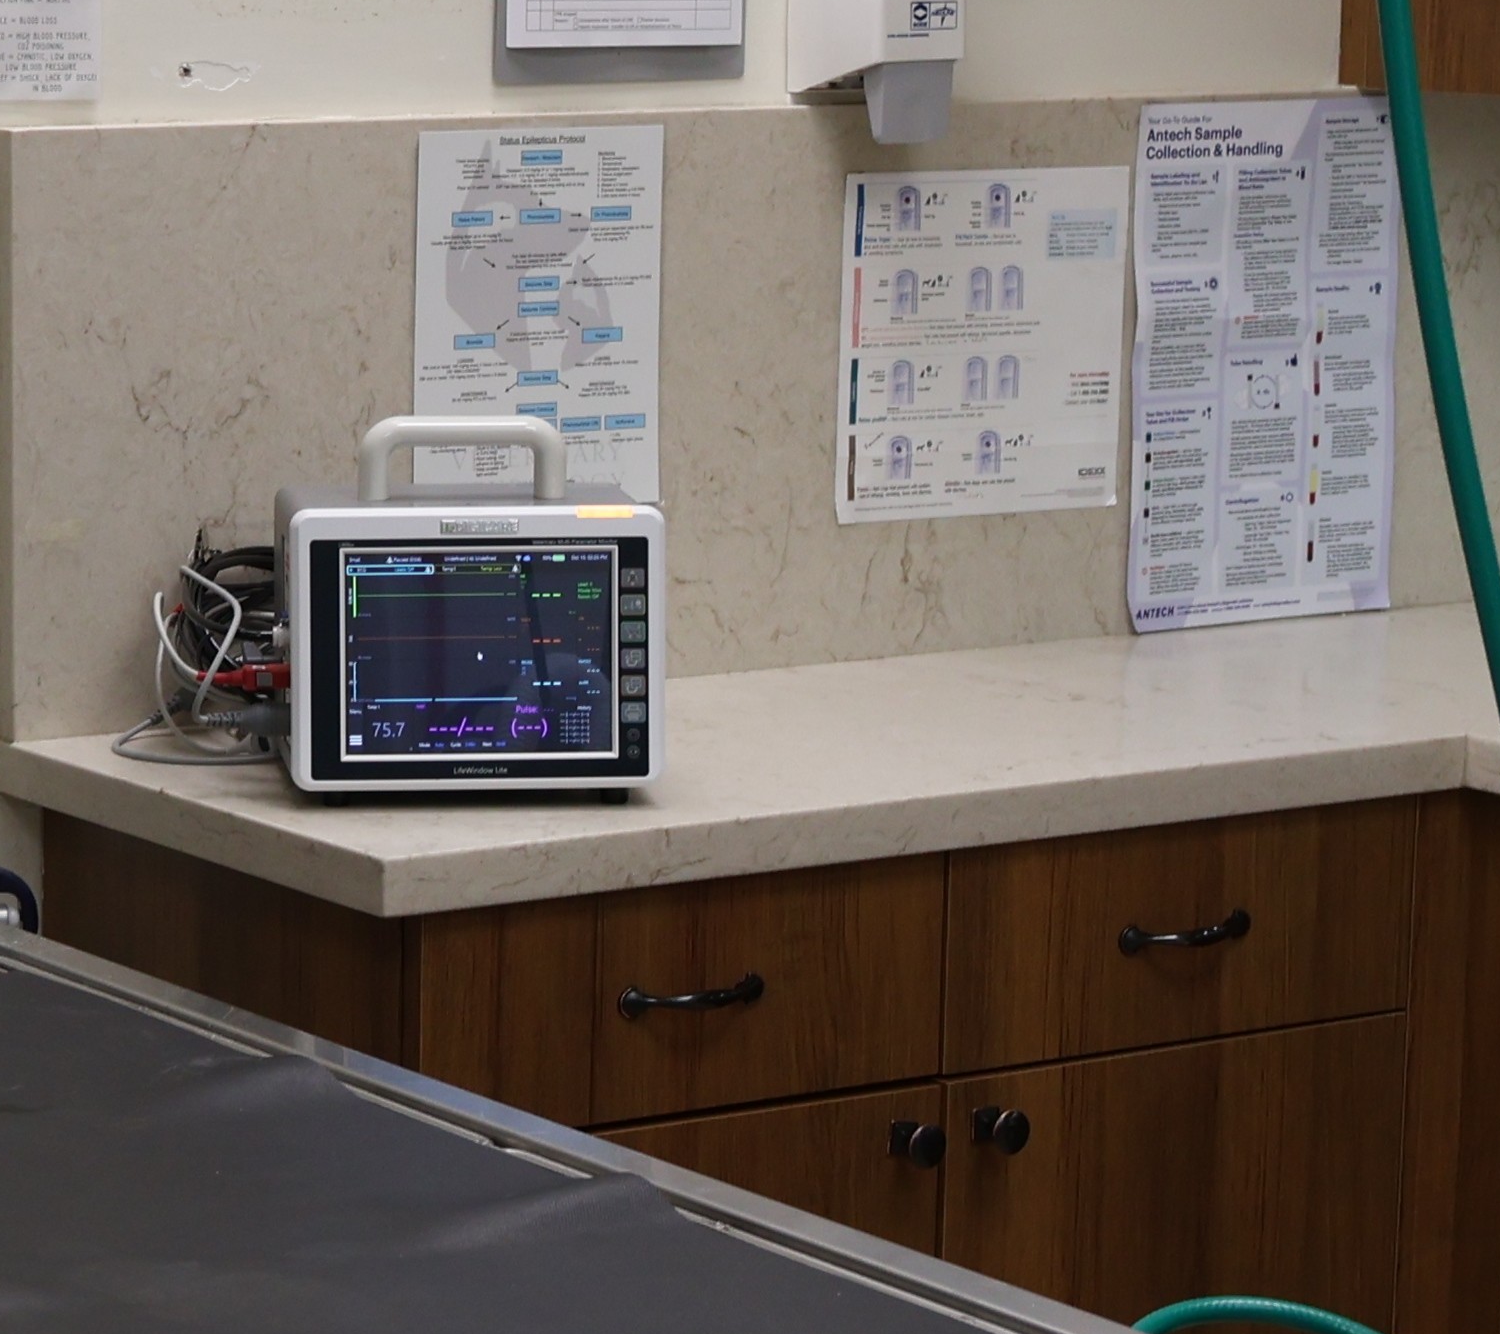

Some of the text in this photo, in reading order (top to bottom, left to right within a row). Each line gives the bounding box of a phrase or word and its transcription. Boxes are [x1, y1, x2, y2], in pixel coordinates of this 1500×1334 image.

[1148, 117, 1161, 125] Your
[1162, 116, 1180, 124] Go-To
[1181, 116, 1200, 124] Guide
[1147, 126, 1242, 142] Antech Sample
[500, 135, 586, 146] Status Epilepticus Protocol
[1146, 142, 1283, 160] Collection & Handling
[1136, 606, 1174, 620] ANTECH
[515, 705, 538, 713] Pulse:
[372, 722, 405, 737] 75.7
[495, 766, 508, 774] Lite
